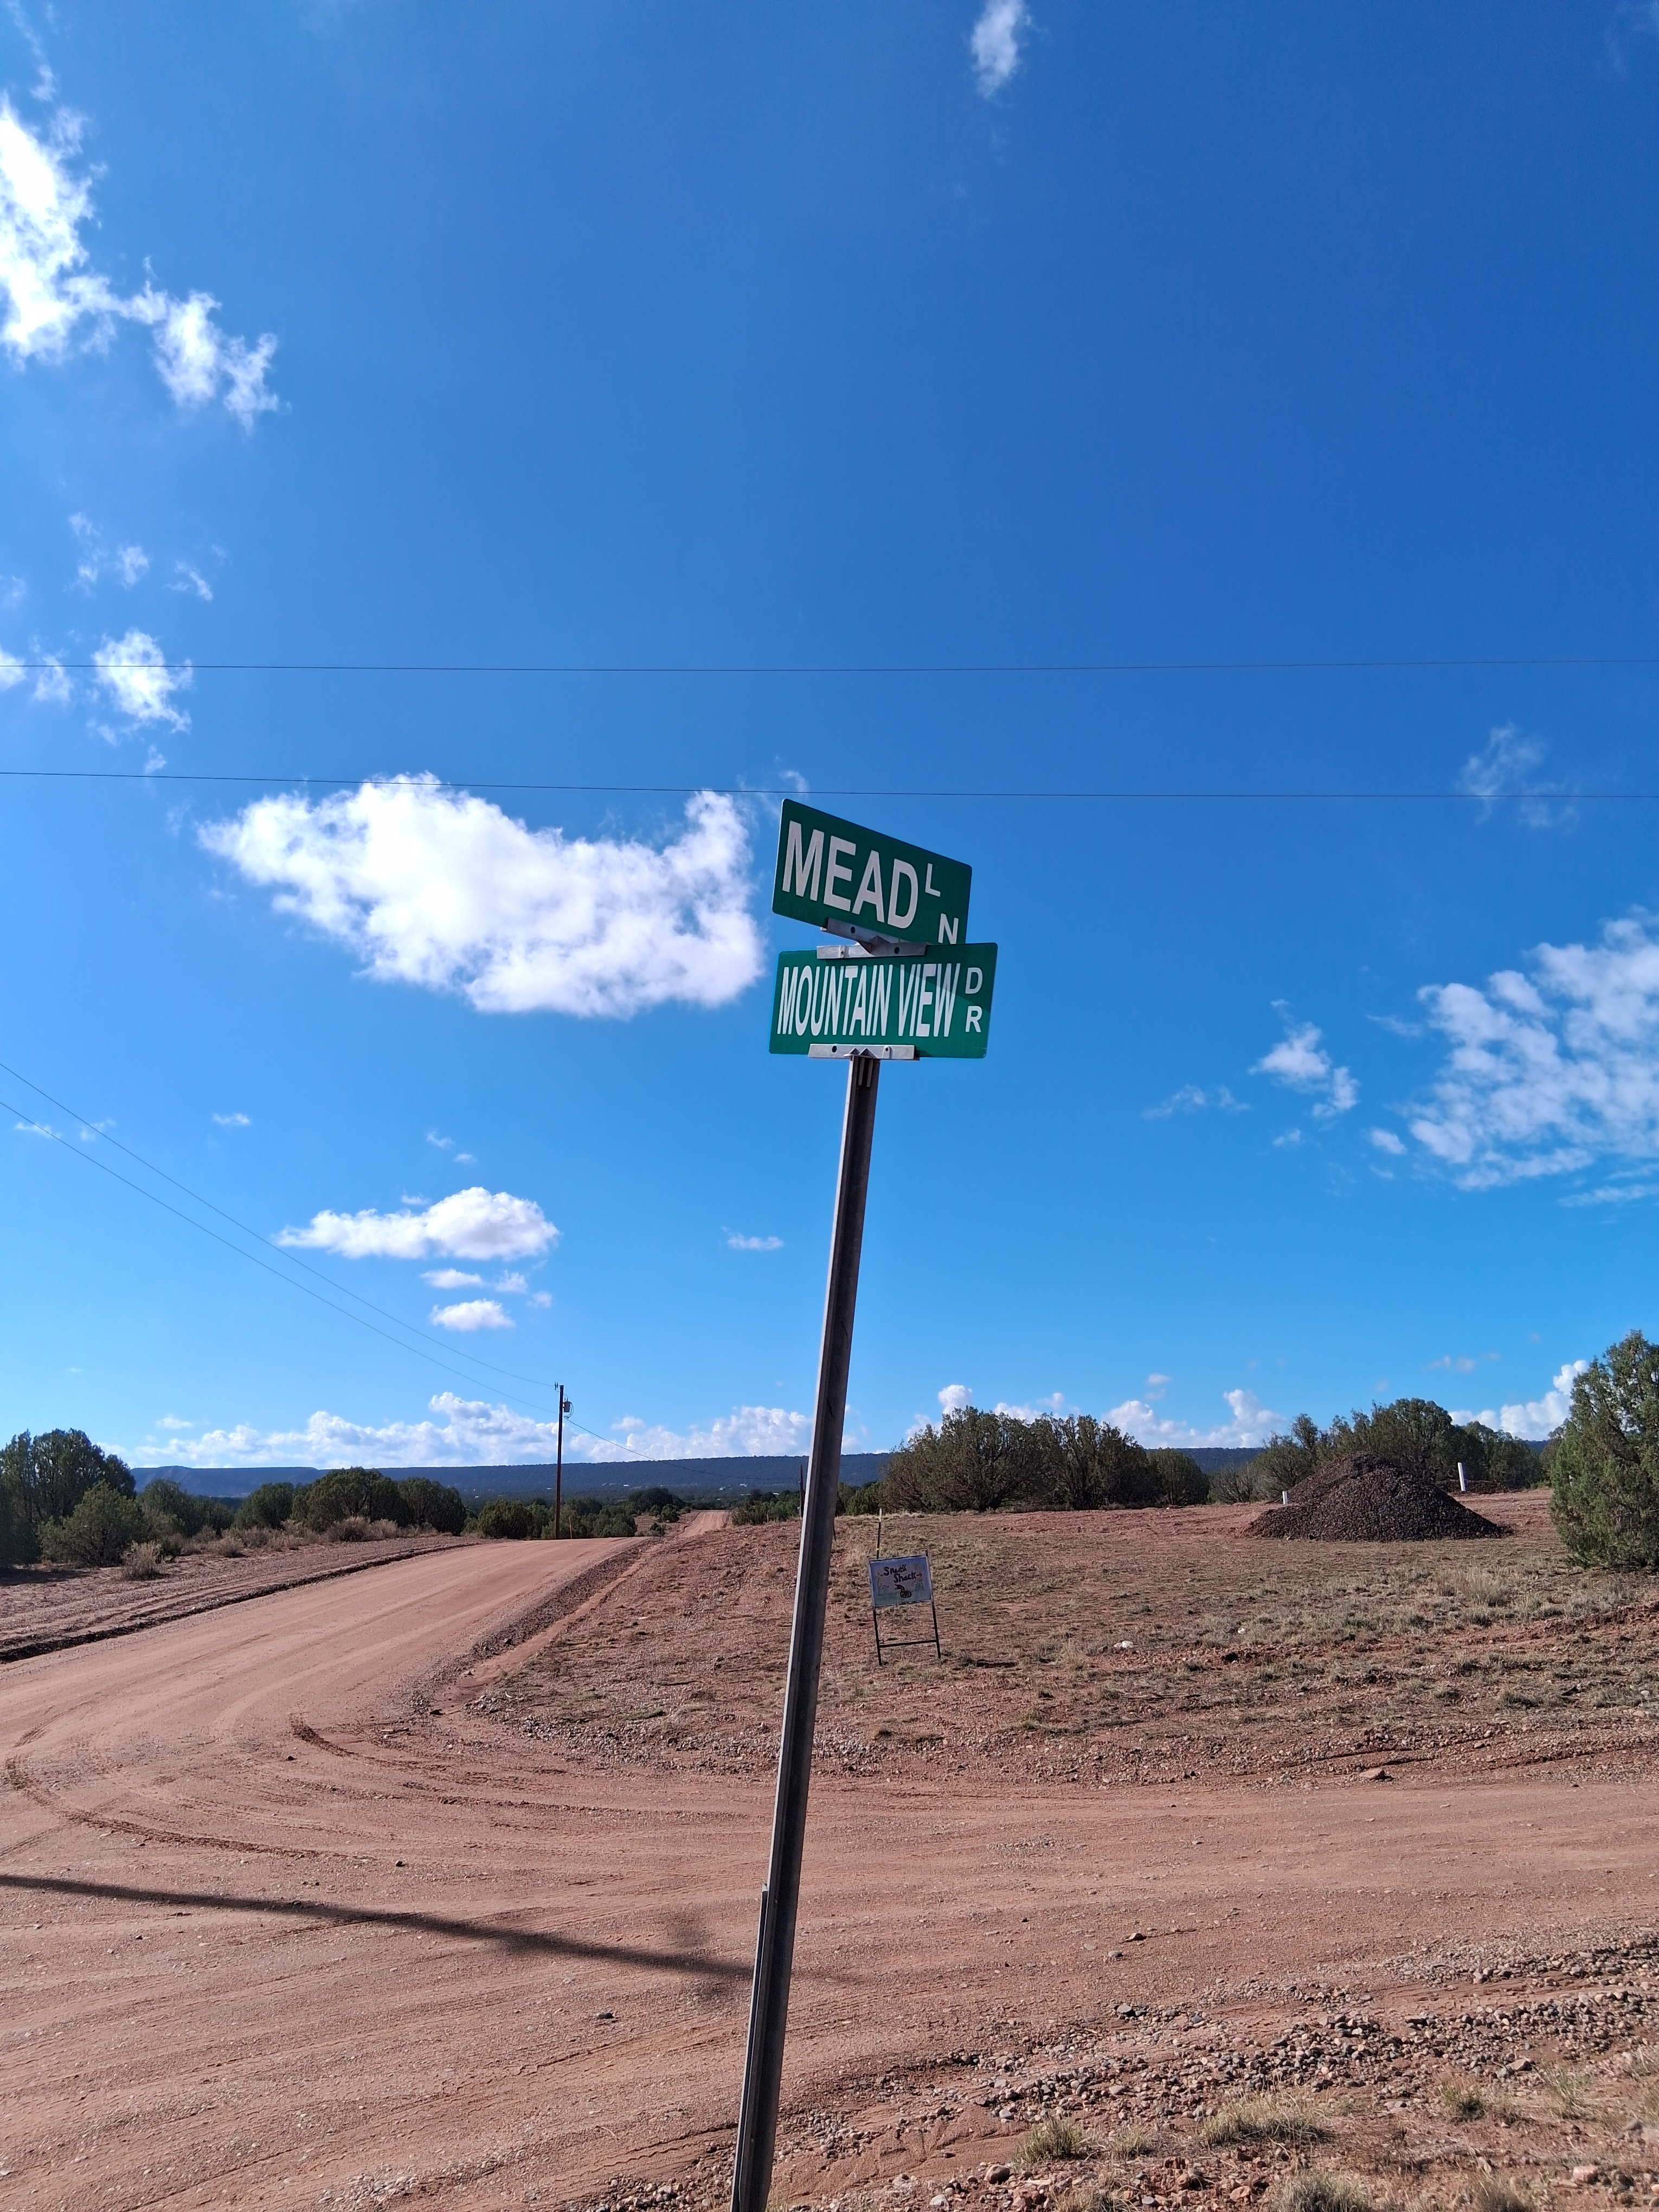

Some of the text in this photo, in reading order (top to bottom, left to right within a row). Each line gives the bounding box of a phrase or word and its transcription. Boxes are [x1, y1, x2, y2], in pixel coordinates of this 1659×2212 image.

[782, 820, 918, 929] MEAD
[776, 962, 983, 1037] MOUNTAIN VIEW DR
